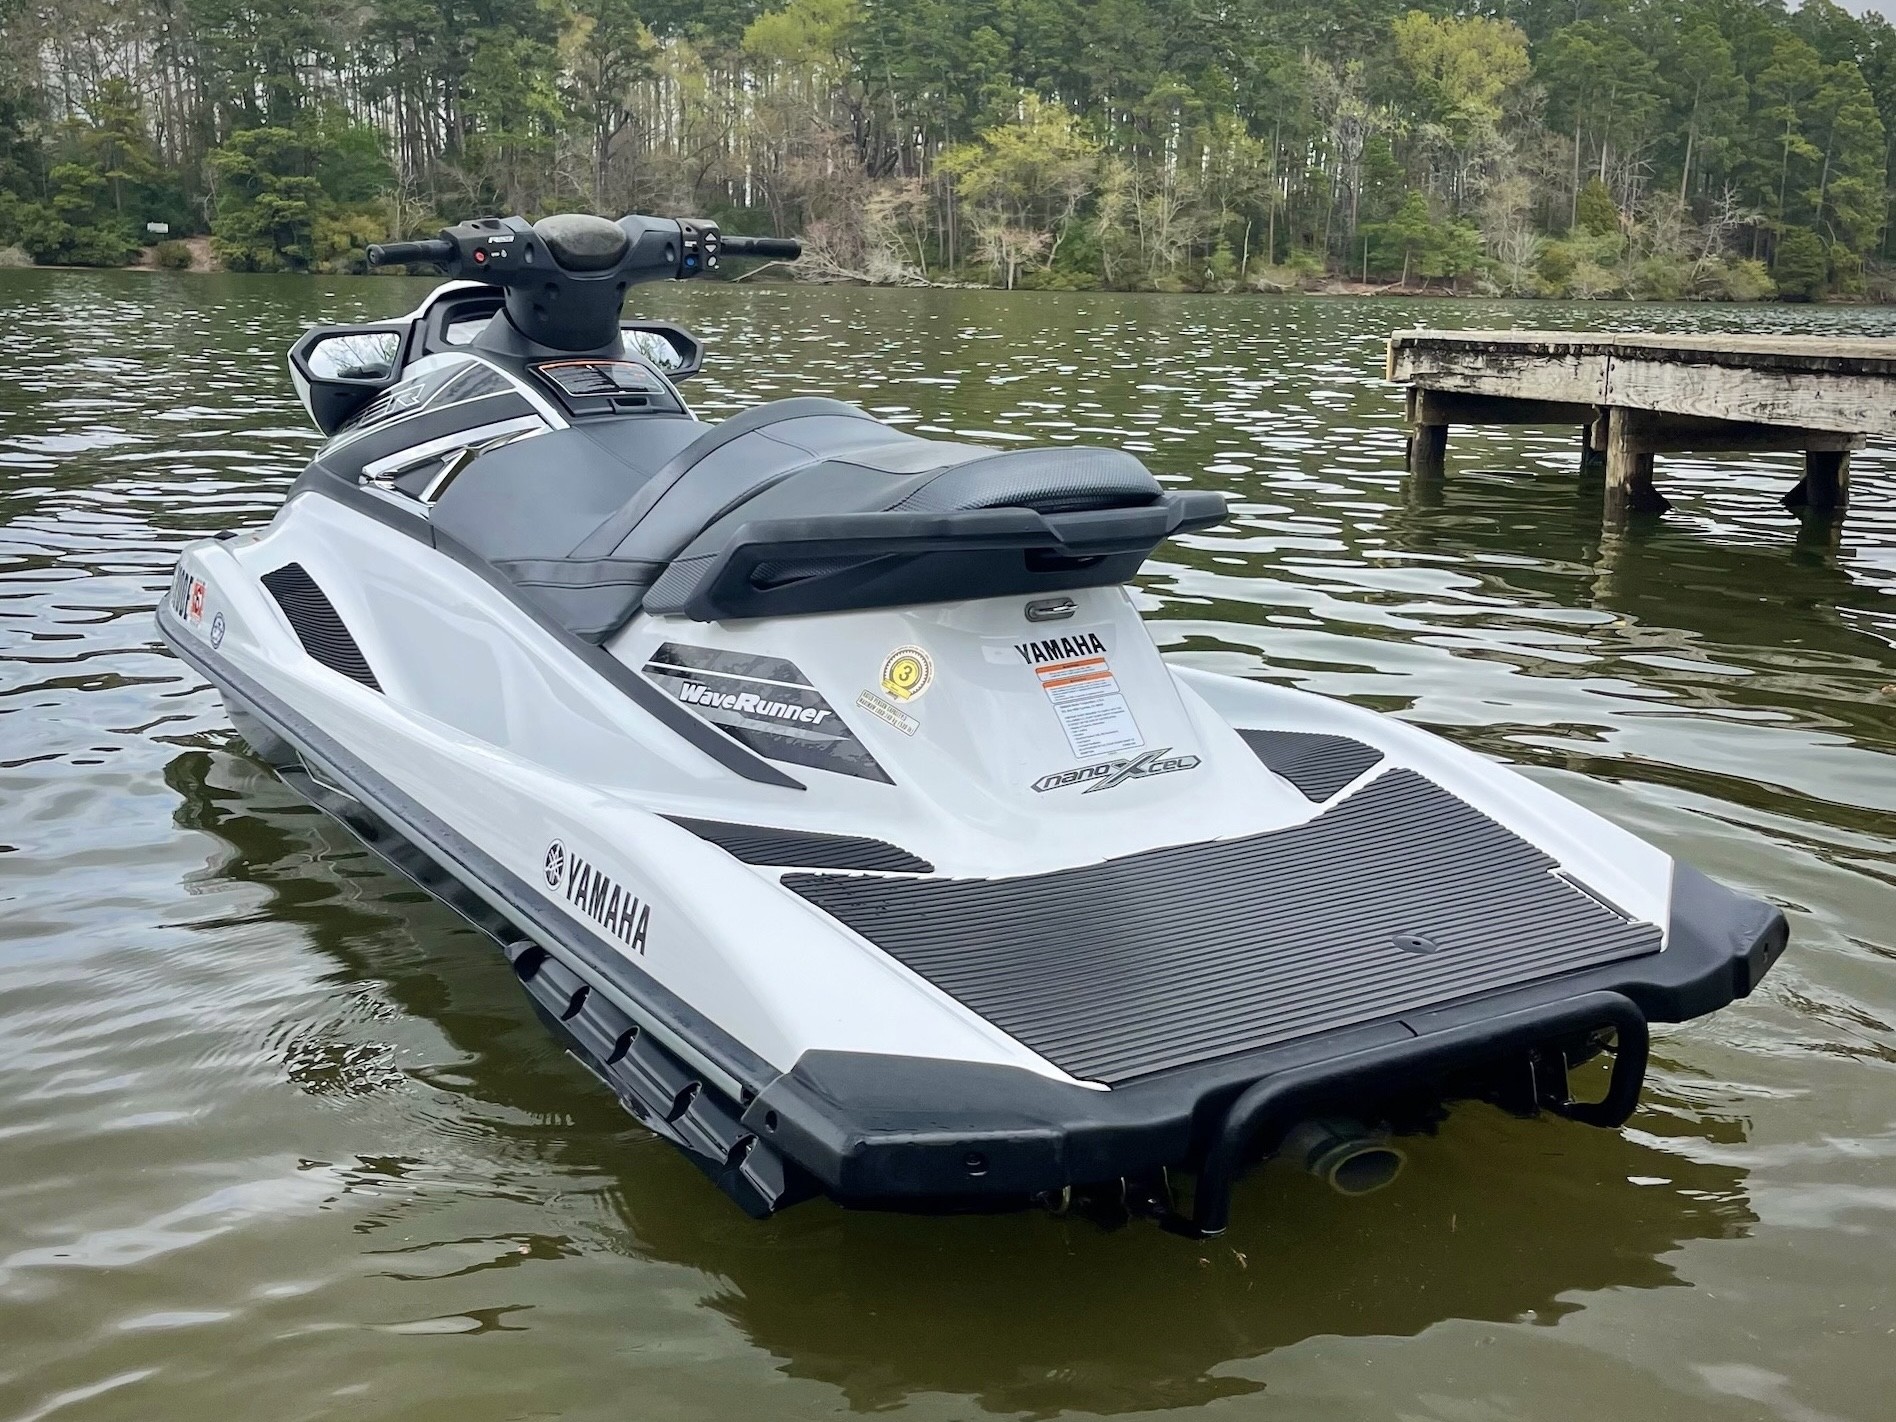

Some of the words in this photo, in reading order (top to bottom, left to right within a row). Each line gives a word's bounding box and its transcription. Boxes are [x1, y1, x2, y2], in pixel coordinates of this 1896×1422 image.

[1014, 633, 1106, 664] YAMAHA
[899, 665, 913, 681] 3
[679, 682, 832, 725] WaveRunner
[566, 852, 651, 956] YAMAHA
